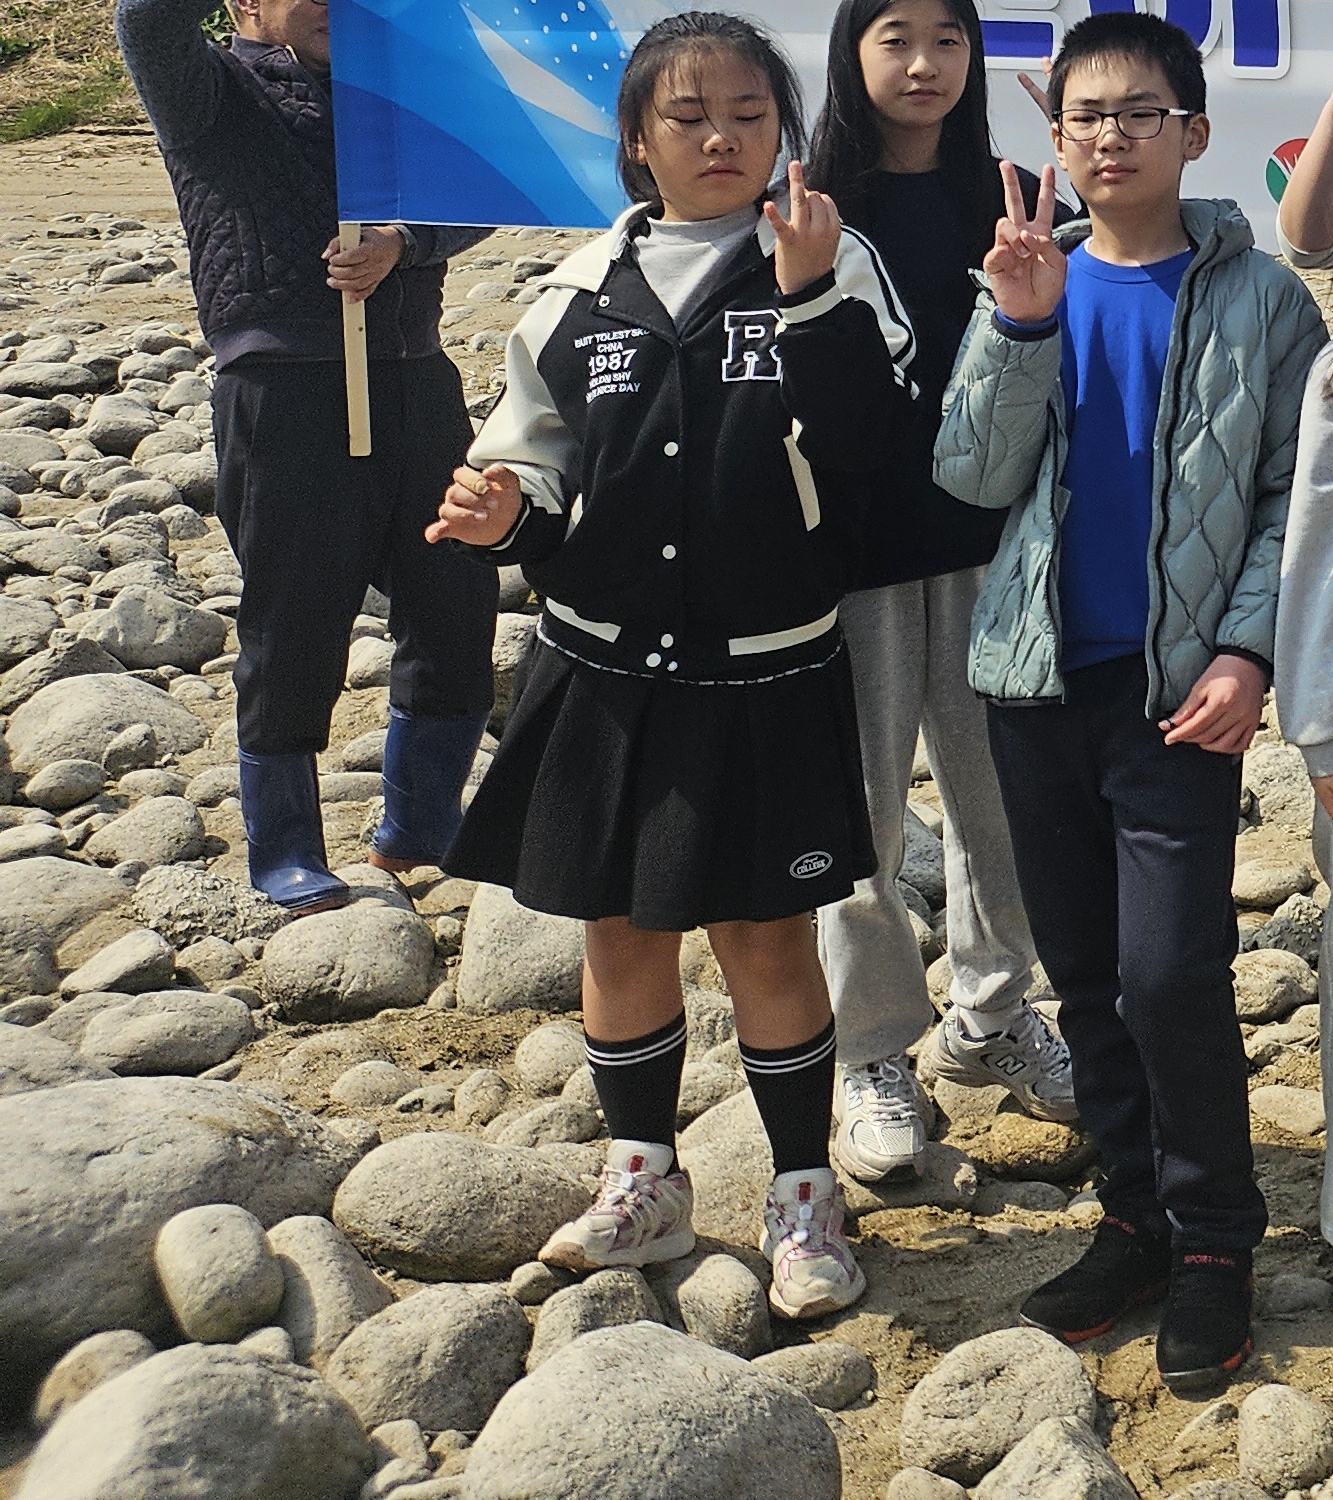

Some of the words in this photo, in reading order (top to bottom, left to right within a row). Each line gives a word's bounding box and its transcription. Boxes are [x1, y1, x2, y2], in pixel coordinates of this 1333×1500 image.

[722, 309, 783, 382] R
[588, 348, 638, 377] 1987
[618, 382, 641, 393] DAY
